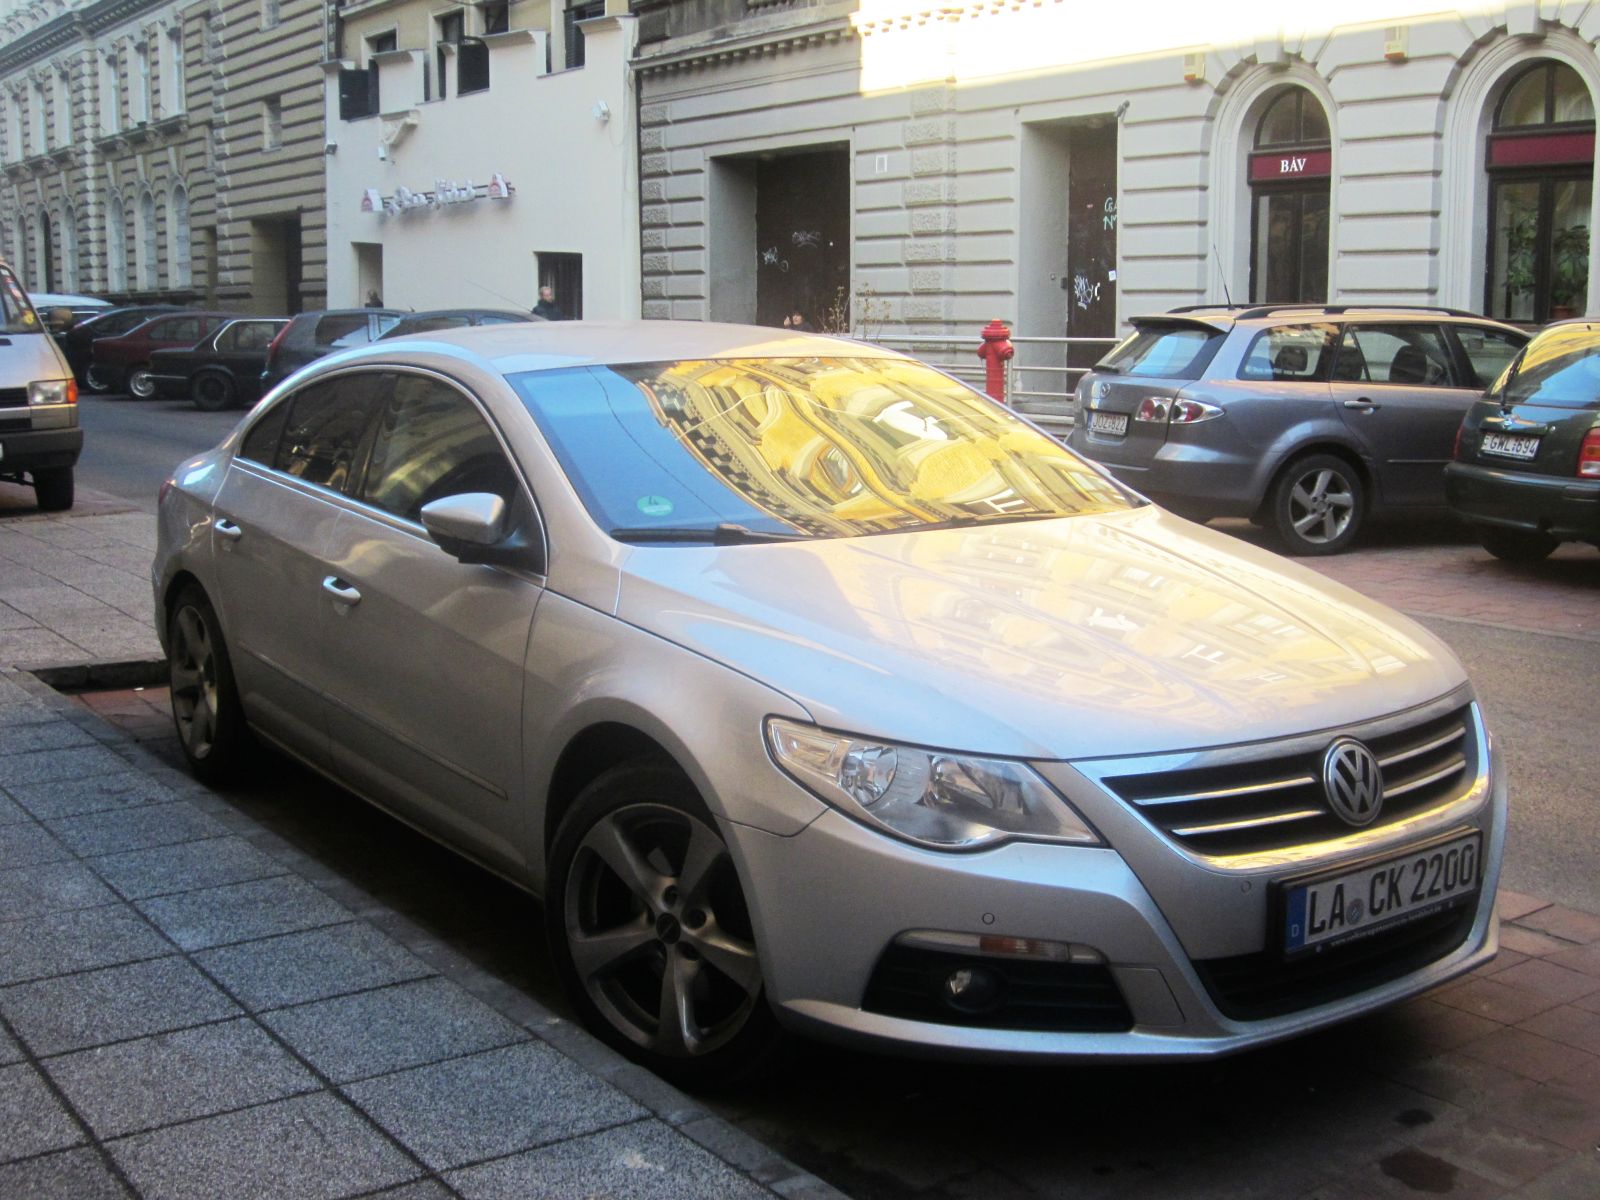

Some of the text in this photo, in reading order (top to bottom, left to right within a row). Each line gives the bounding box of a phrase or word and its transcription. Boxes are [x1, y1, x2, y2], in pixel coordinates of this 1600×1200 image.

[1280, 156, 1307, 173] BÁV
[1291, 924, 1299, 938] D
[1308, 883, 1345, 936] LA
[1369, 864, 1405, 917] CK
[1411, 844, 1474, 903] 2200
